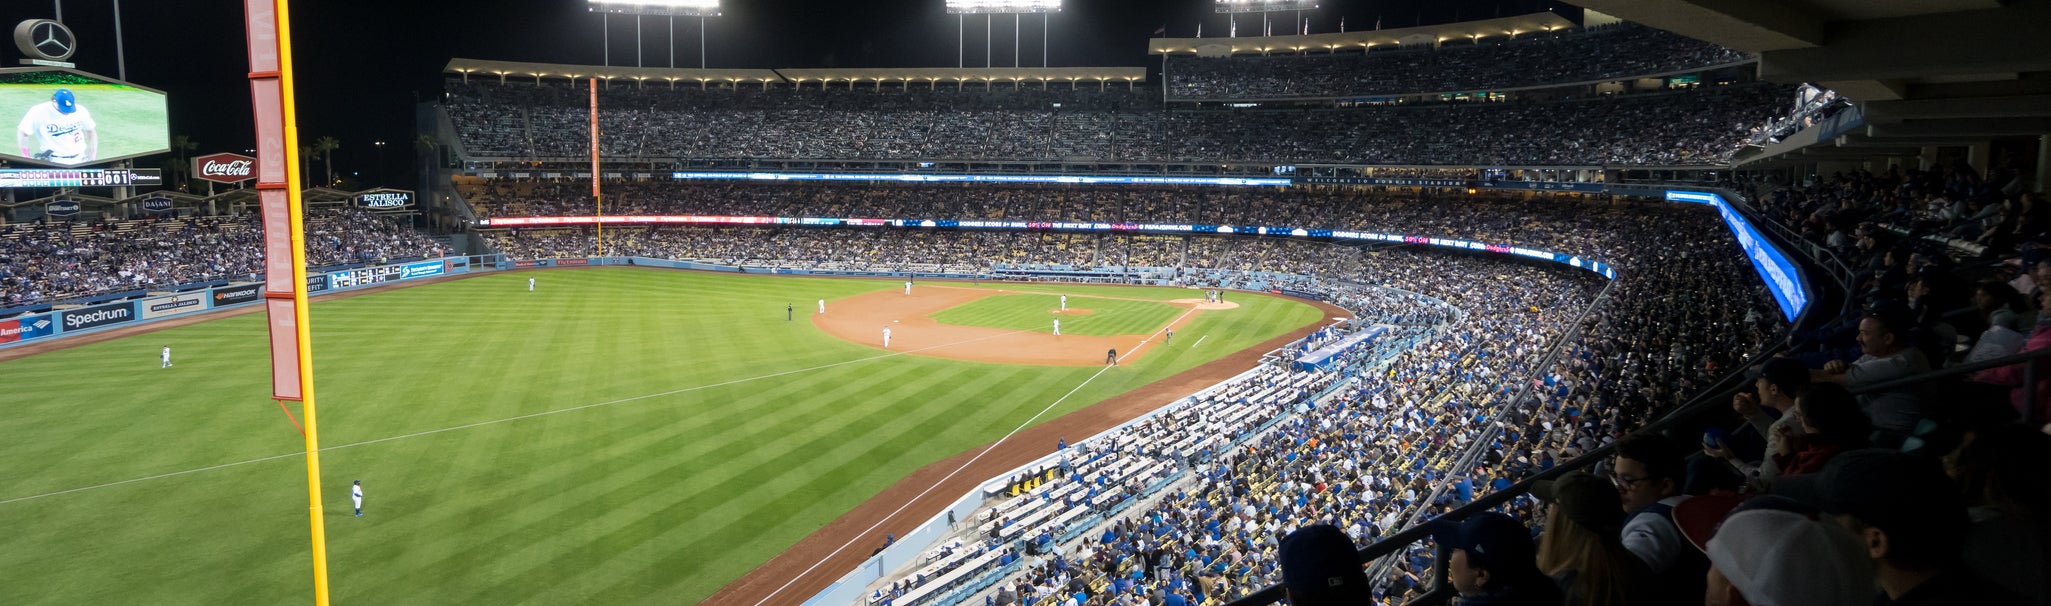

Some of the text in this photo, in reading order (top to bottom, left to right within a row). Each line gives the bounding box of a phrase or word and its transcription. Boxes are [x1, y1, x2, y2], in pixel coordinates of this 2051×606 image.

[203, 160, 252, 176] Coca-Cola
[364, 193, 408, 201] ESTRELLA
[67, 308, 127, 327] Spectrum
[1, 326, 32, 336] America
